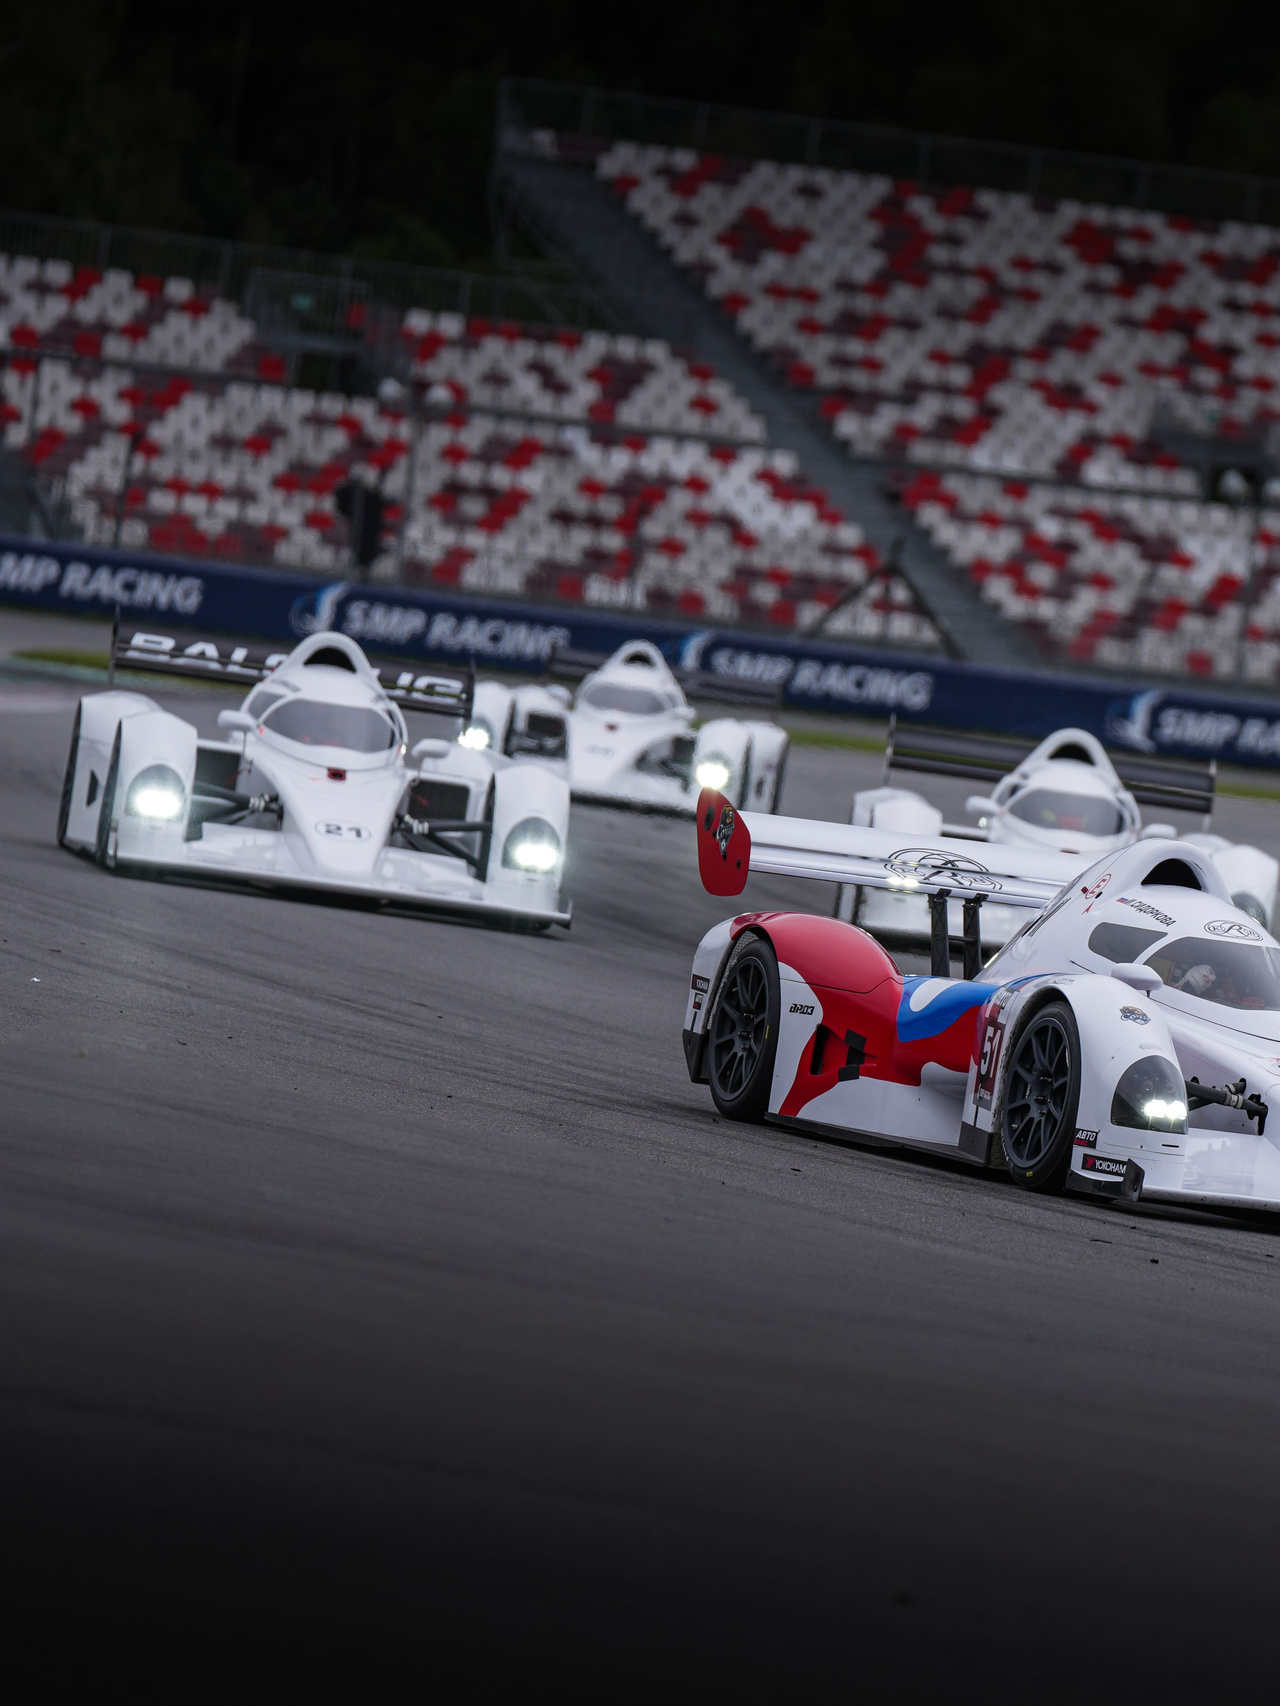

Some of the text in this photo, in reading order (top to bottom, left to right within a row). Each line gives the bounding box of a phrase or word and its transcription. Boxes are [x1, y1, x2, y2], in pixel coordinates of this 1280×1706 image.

[0, 553, 203, 615] MP RACING
[342, 600, 428, 645] SMP
[788, 660, 935, 712] RACING
[1154, 708, 1240, 748] SMP
[324, 823, 362, 838] 21
[980, 1025, 1002, 1078] 51
[1075, 1130, 1096, 1141] АВТО
[1095, 1159, 1127, 1174] YOKOHAM
